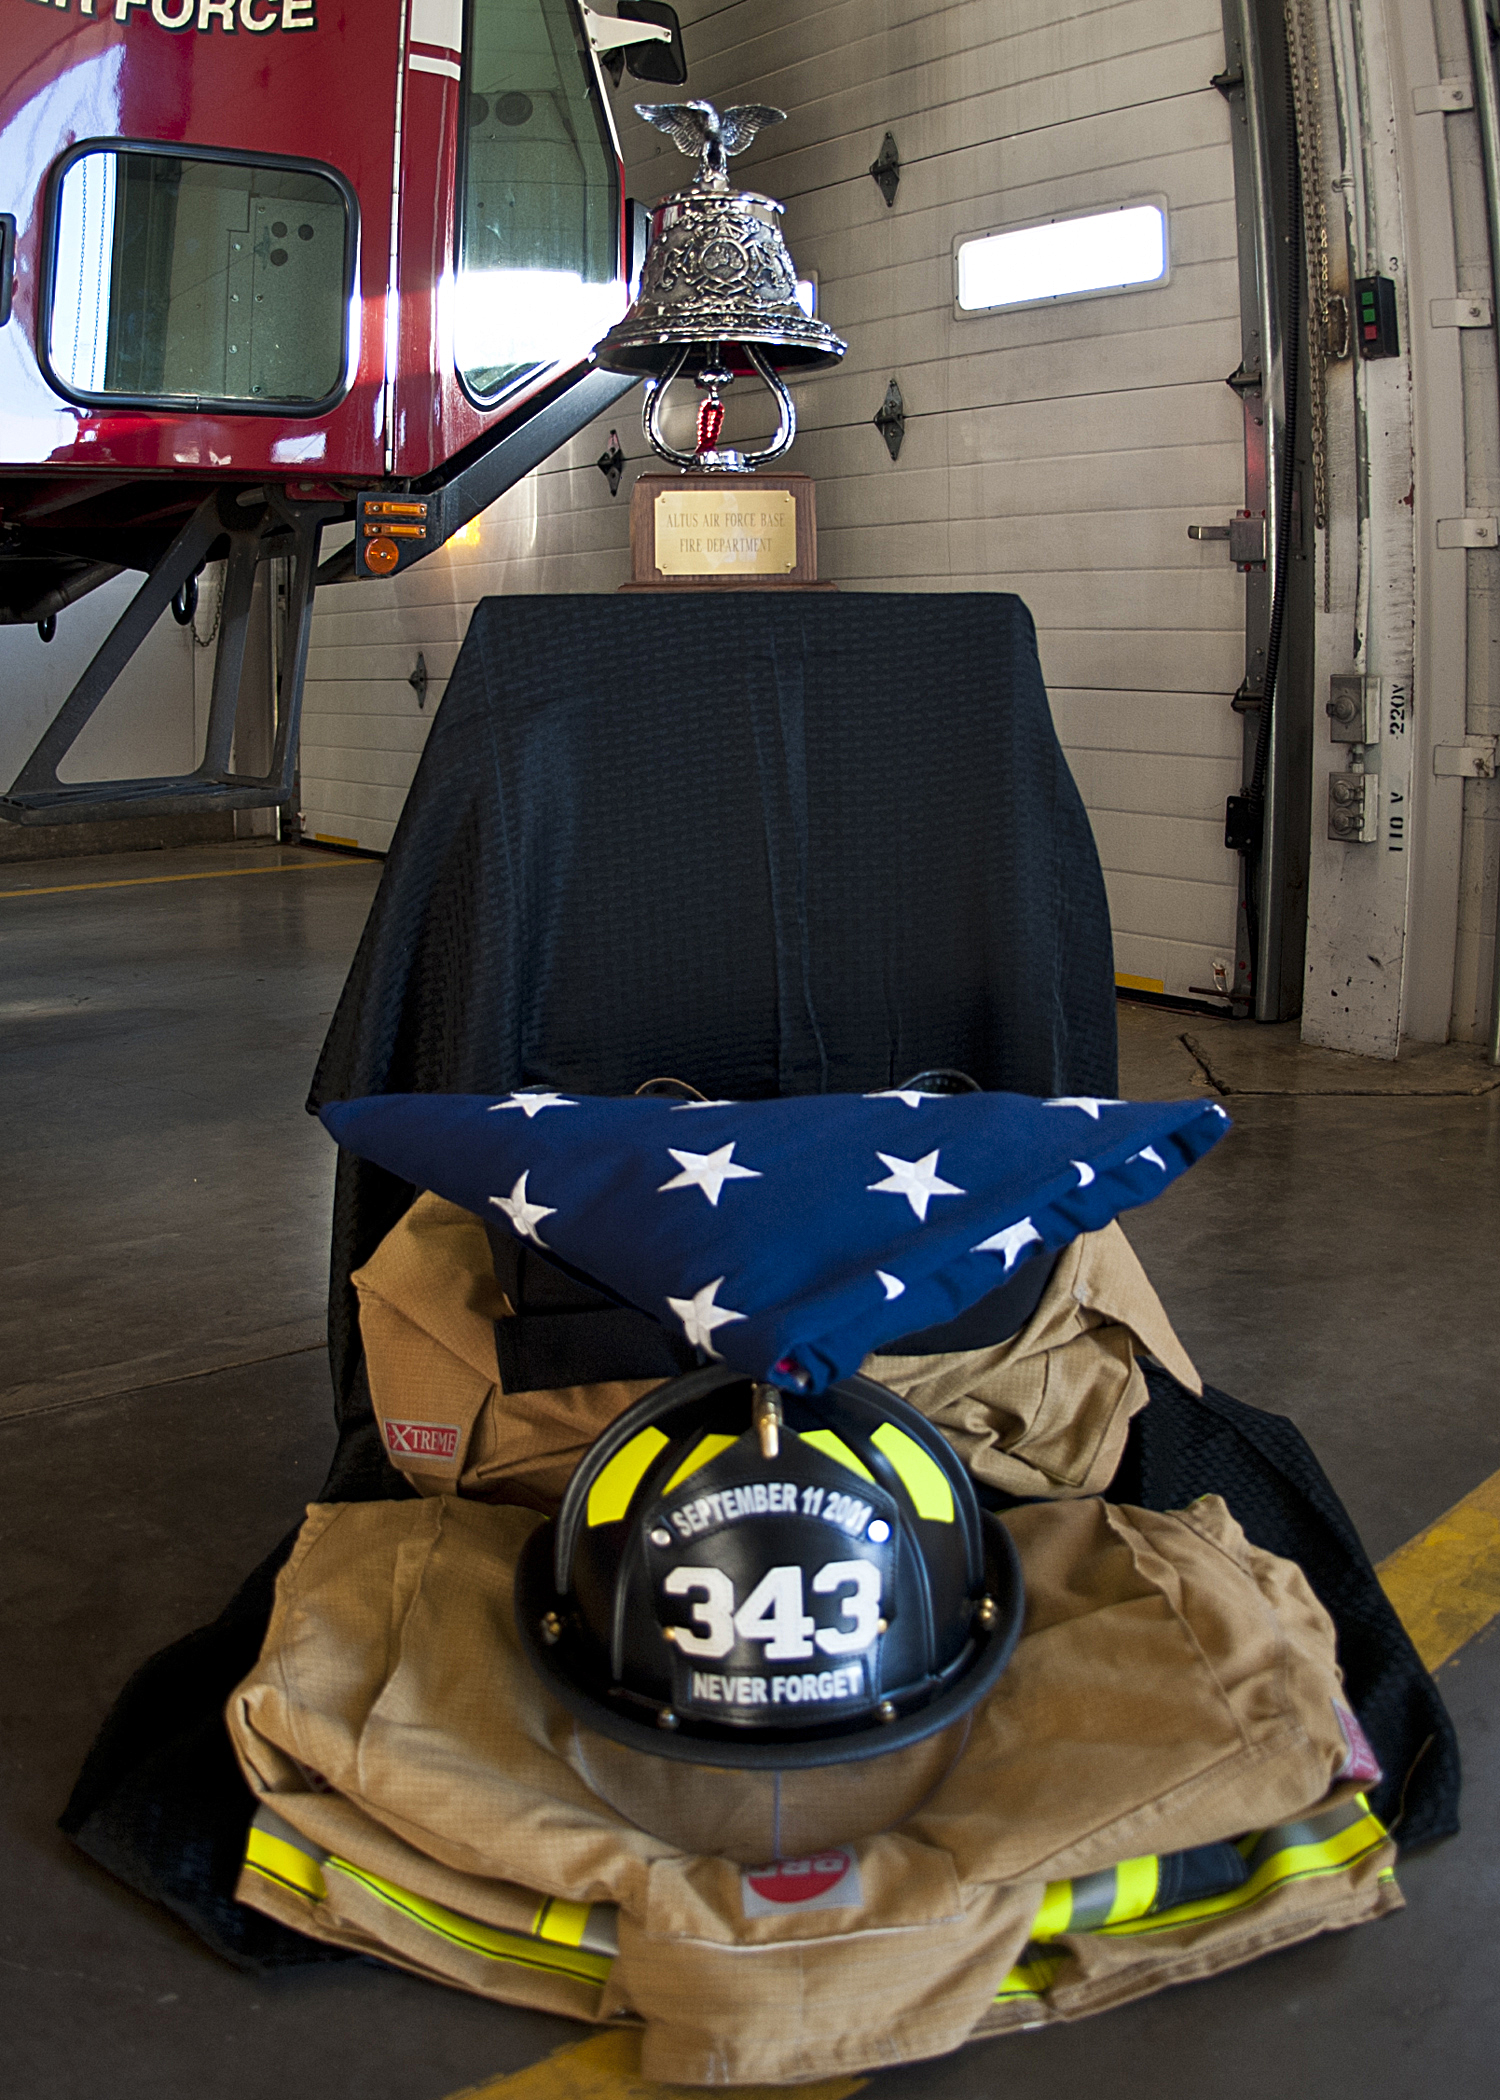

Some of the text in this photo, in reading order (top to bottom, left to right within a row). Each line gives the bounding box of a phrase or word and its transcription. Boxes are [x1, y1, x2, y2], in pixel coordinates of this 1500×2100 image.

[1389, 256, 1399, 272] 3
[667, 513, 785, 528] ALTUS AIR FORCE BASE
[680, 538, 772, 552] FIRE DEPARTMENT
[1389, 684, 1405, 735] 220V
[1388, 791, 1404, 852] 110 V
[390, 1424, 457, 1454] XTREME
[671, 1483, 873, 1538] SEPTEMBER 11 2001
[664, 1559, 881, 1659] 343
[693, 1667, 863, 1704] NEVER FORGET
